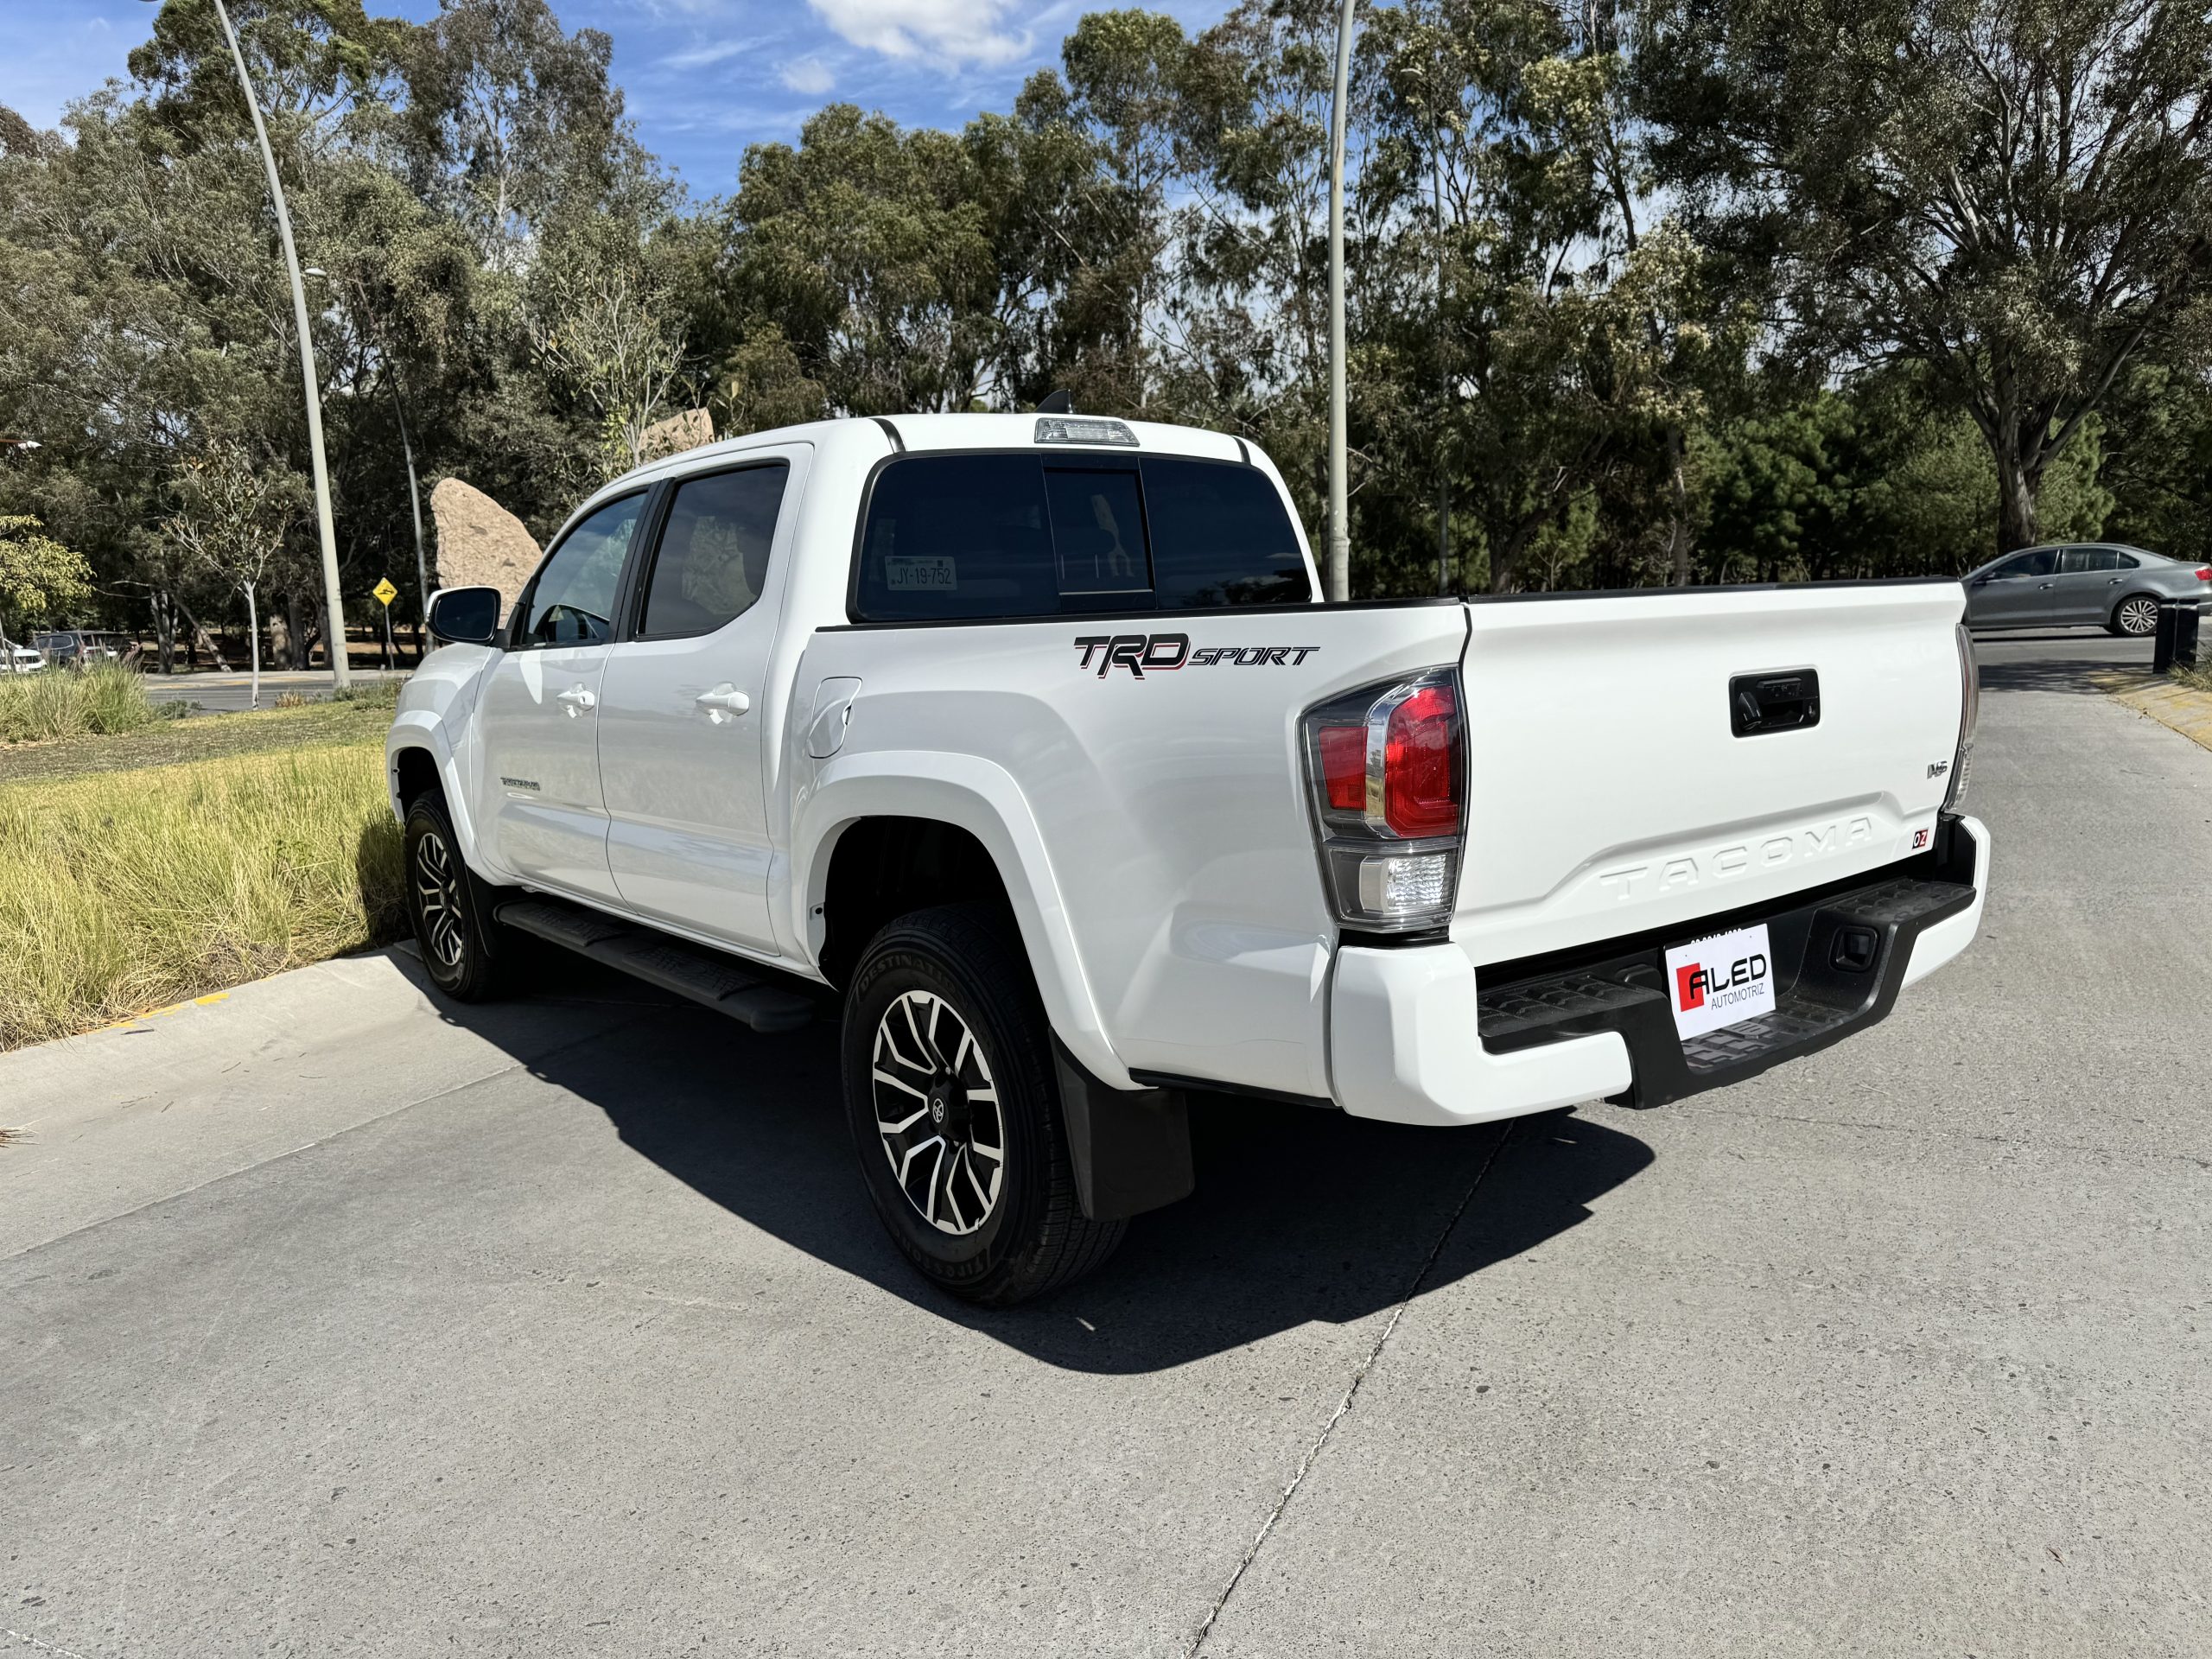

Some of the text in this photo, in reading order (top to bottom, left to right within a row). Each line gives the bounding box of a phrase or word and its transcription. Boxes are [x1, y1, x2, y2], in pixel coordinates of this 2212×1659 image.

[897, 567, 952, 584] JY-19-752
[1073, 632, 1321, 680] TRD SPORT
[1599, 817, 1872, 899] TACOMA
[1688, 953, 1767, 1000] ALED
[1711, 982, 1765, 1010] AUTOMOTRIZ
